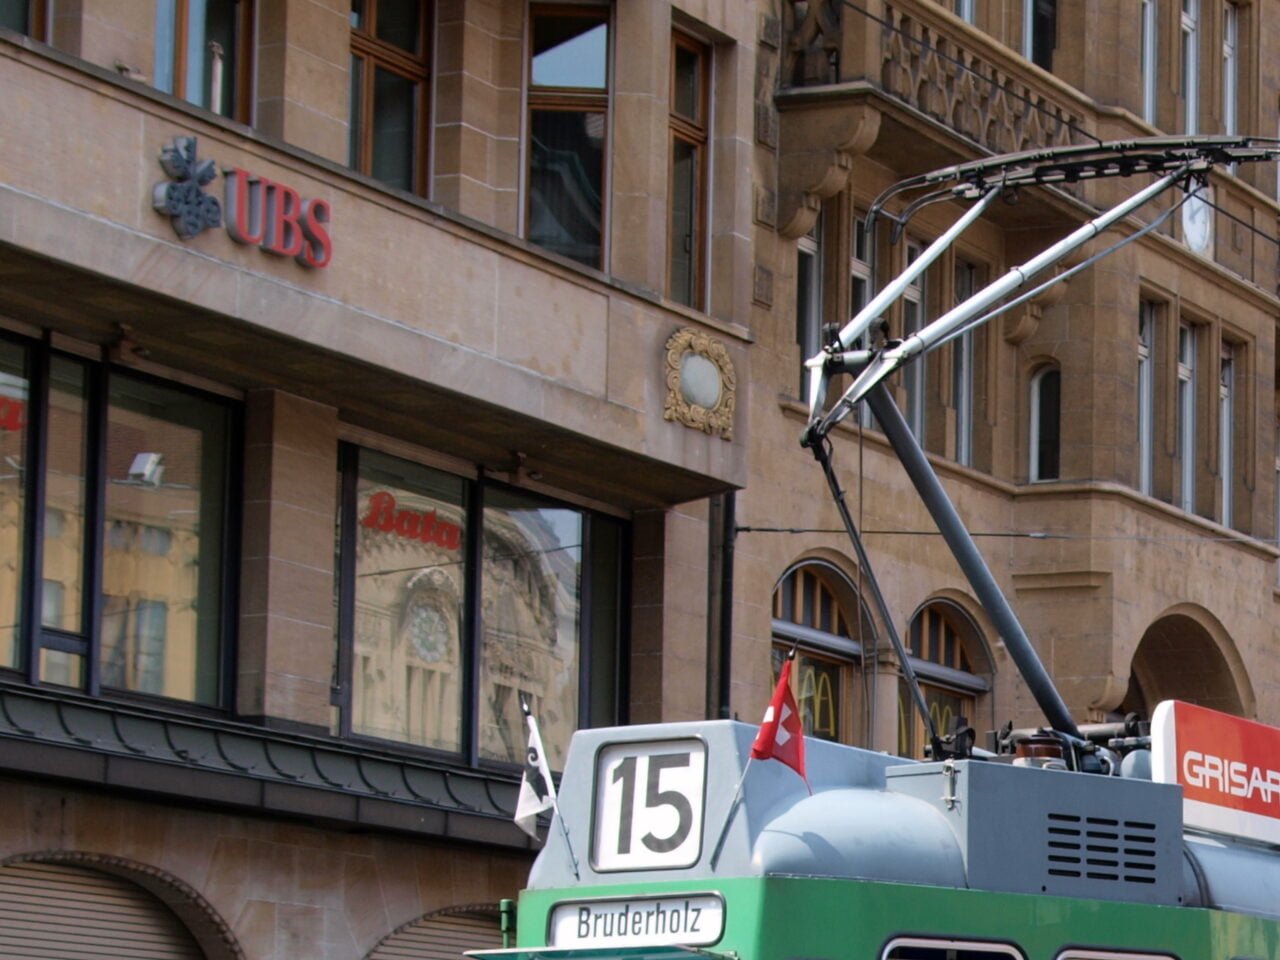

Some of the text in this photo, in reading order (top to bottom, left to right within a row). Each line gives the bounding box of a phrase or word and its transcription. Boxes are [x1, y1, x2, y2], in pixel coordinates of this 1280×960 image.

[222, 167, 333, 268] UBS
[362, 491, 464, 550] Bata
[612, 752, 693, 854] 15
[576, 901, 702, 939] Bruderholz
